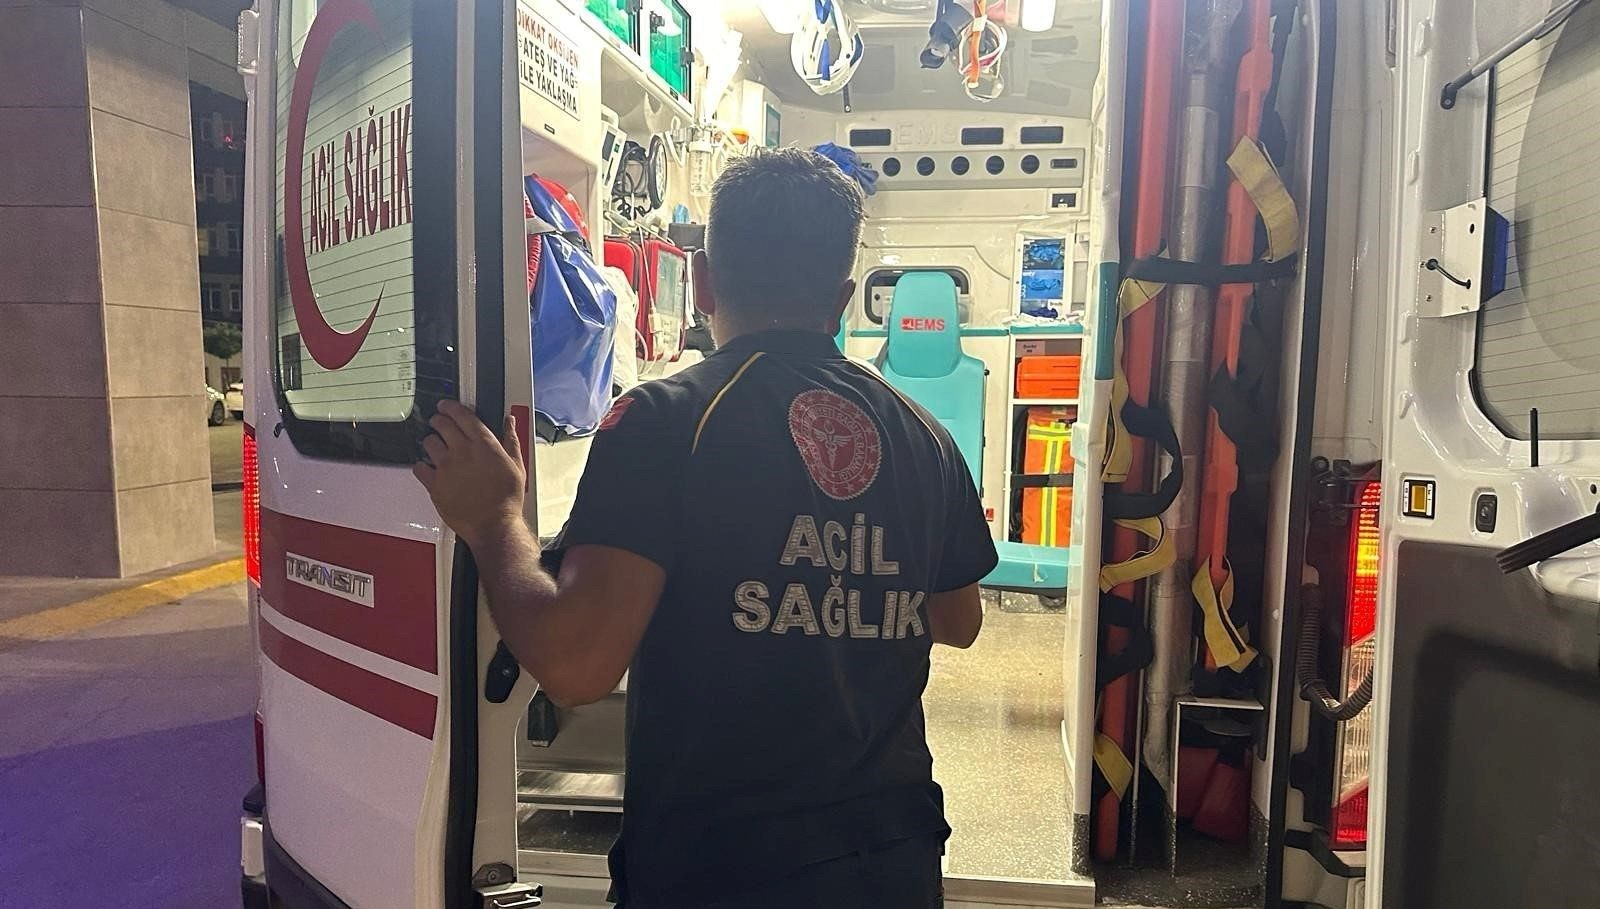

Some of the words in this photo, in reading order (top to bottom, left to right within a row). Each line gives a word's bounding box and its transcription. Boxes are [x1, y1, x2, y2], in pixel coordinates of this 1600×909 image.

[523, 38, 545, 73] ATEŞ
[547, 54, 558, 77] VE
[520, 60, 534, 85] İLE
[536, 70, 577, 114] YAKLAŞMA
[310, 140, 340, 254] ACİL
[344, 104, 412, 242] SAĞLIK
[915, 318, 945, 331] EMS
[780, 513, 900, 576] ACİL
[286, 556, 371, 597] TRANSIT
[732, 574, 926, 640] SAĞLIK
